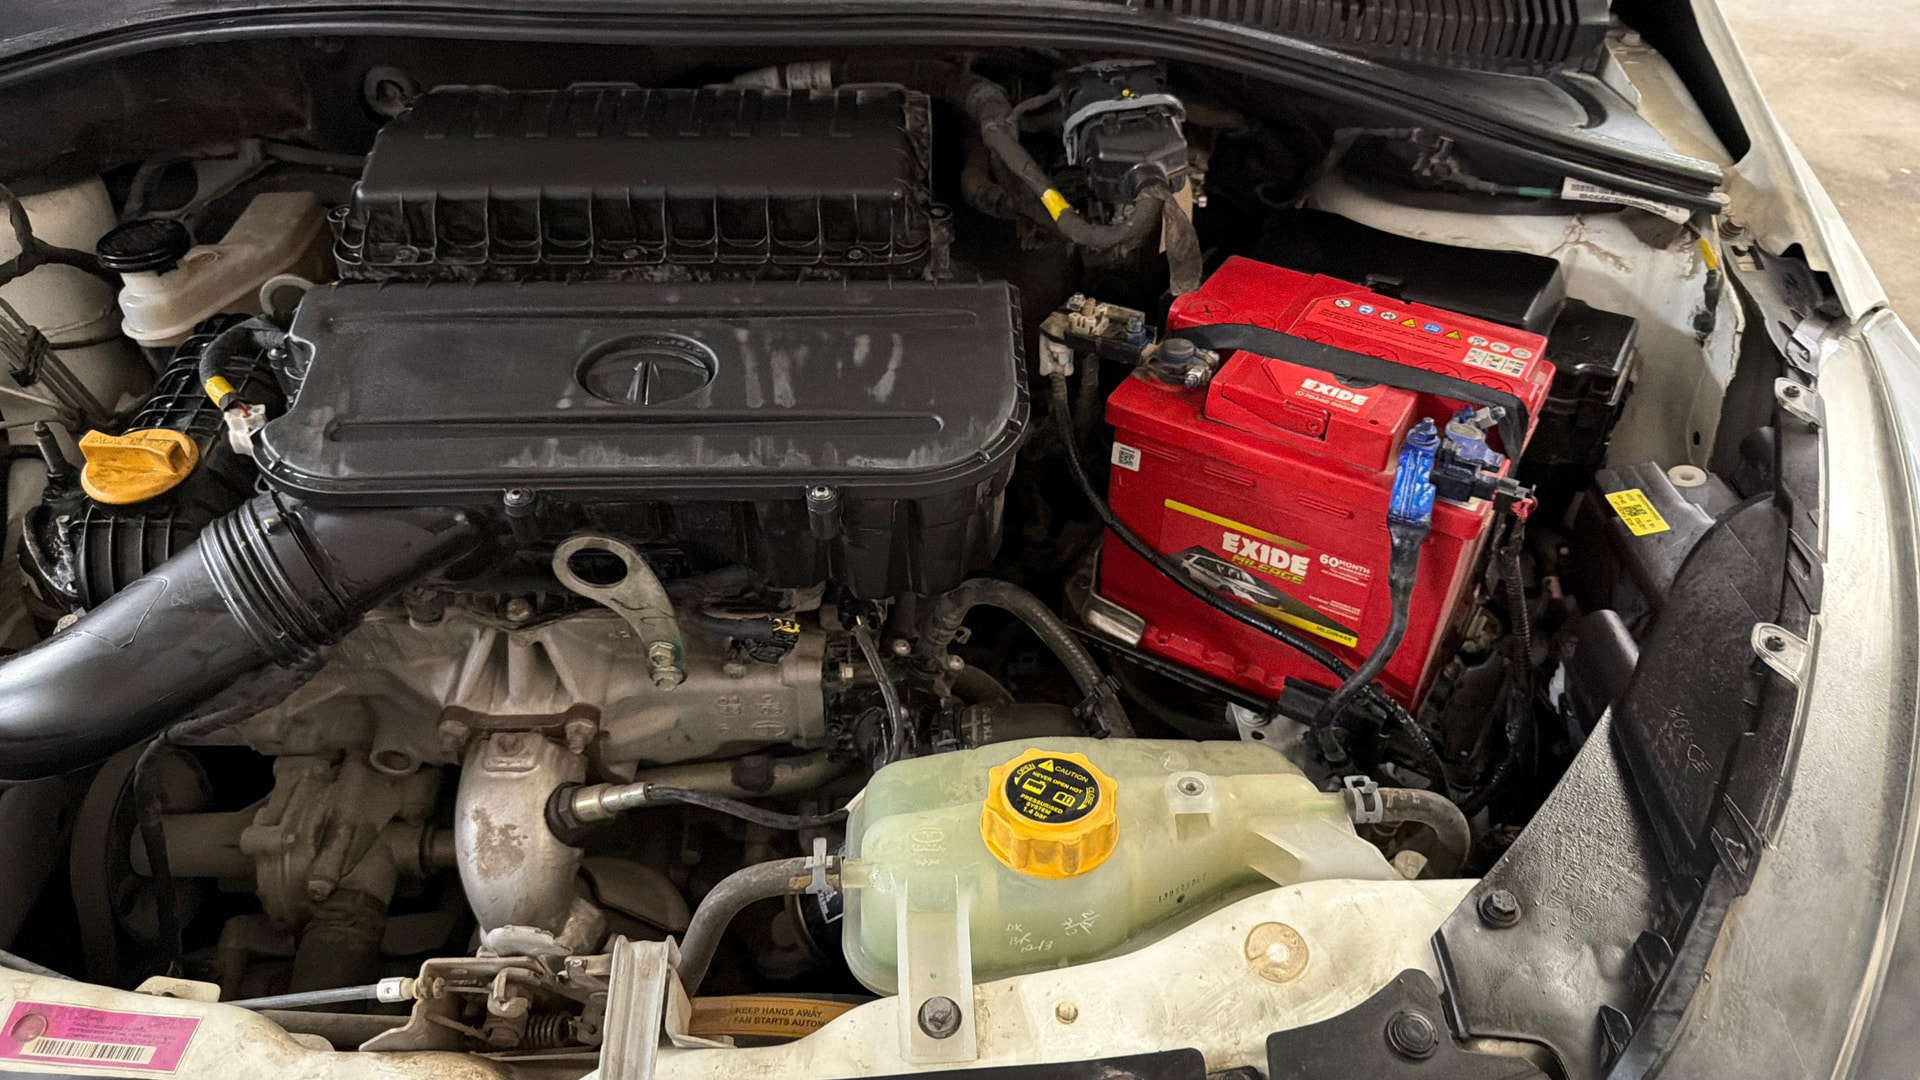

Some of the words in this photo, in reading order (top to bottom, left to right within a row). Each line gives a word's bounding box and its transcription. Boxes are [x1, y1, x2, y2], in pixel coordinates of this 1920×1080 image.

[1300, 378, 1370, 406] EXIDE
[1221, 530, 1310, 577] EXIDE
[1319, 553, 1339, 568] 60
[1338, 559, 1371, 574] MONTH
[1231, 554, 1307, 585] MILEAGE
[1016, 762, 1036, 775] OPEN
[1054, 765, 1089, 783] CAUTION
[1032, 771, 1053, 783] NEVER
[1052, 779, 1070, 789] OPEN
[1069, 785, 1084, 795] HOT
[1019, 793, 1064, 815] PRESSURISED
[1087, 786, 1096, 806] CLOSE
[1022, 806, 1034, 815] 1.4
[1033, 810, 1048, 820] bar
[1025, 801, 1052, 815] SYSTEM
[733, 1016, 752, 1025] FAN
[754, 1016, 790, 1027] STARTS
[791, 1018, 829, 1029] AUTOM
[735, 1006, 761, 1016] KEEP
[762, 1007, 794, 1017] HANDS
[797, 1008, 823, 1018] AWAY
